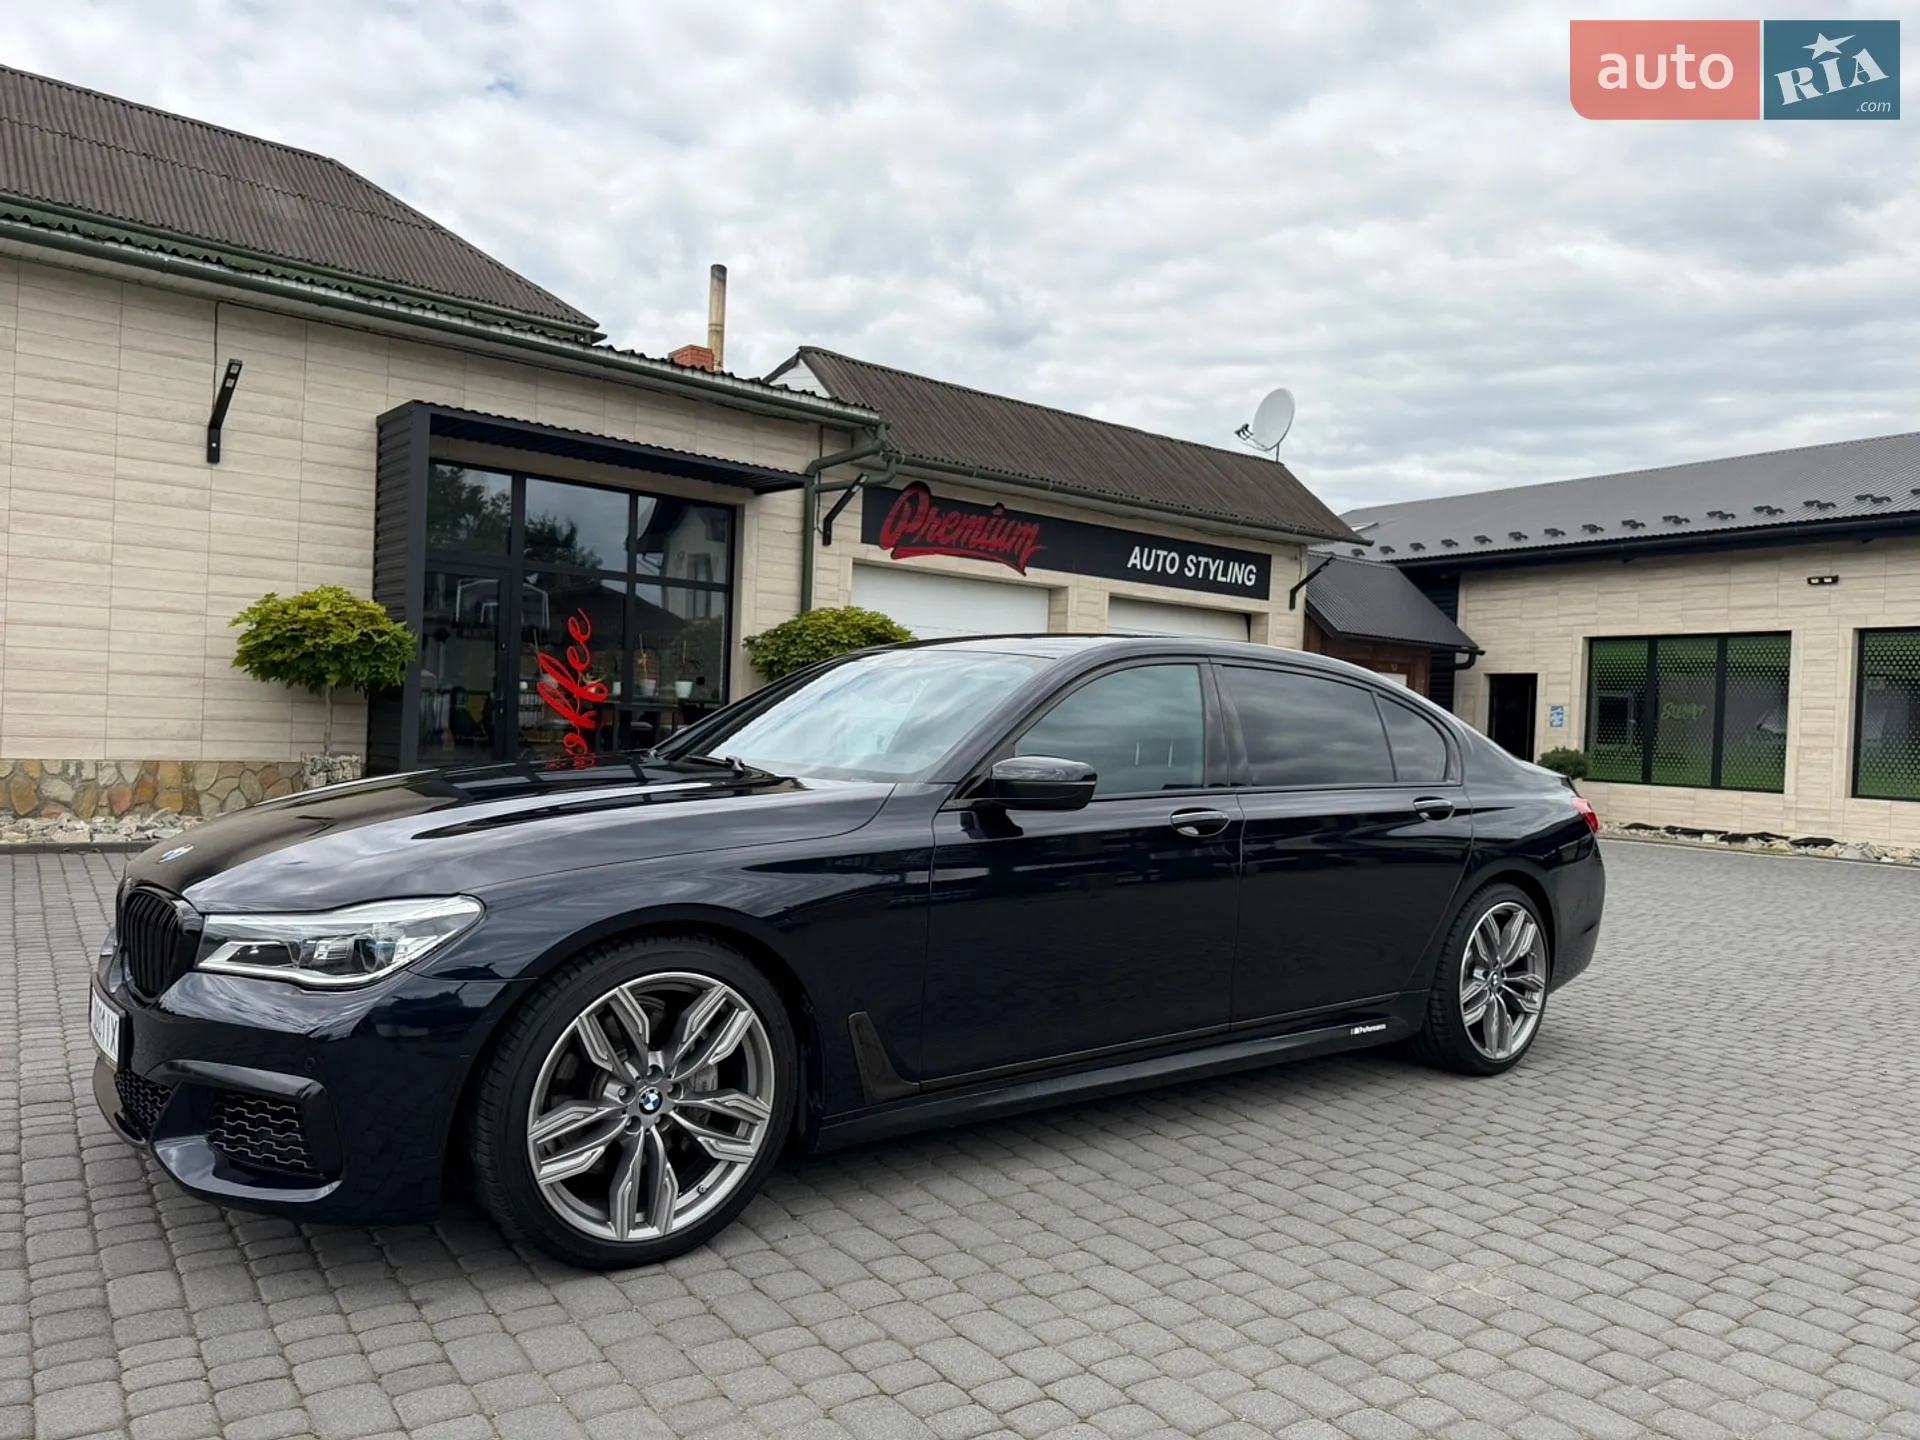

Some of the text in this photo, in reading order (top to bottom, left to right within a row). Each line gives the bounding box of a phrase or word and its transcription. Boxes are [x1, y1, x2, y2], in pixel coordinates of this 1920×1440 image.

[880, 481, 1047, 574] Premium
[1127, 546, 1257, 586] AUTO STYLING
